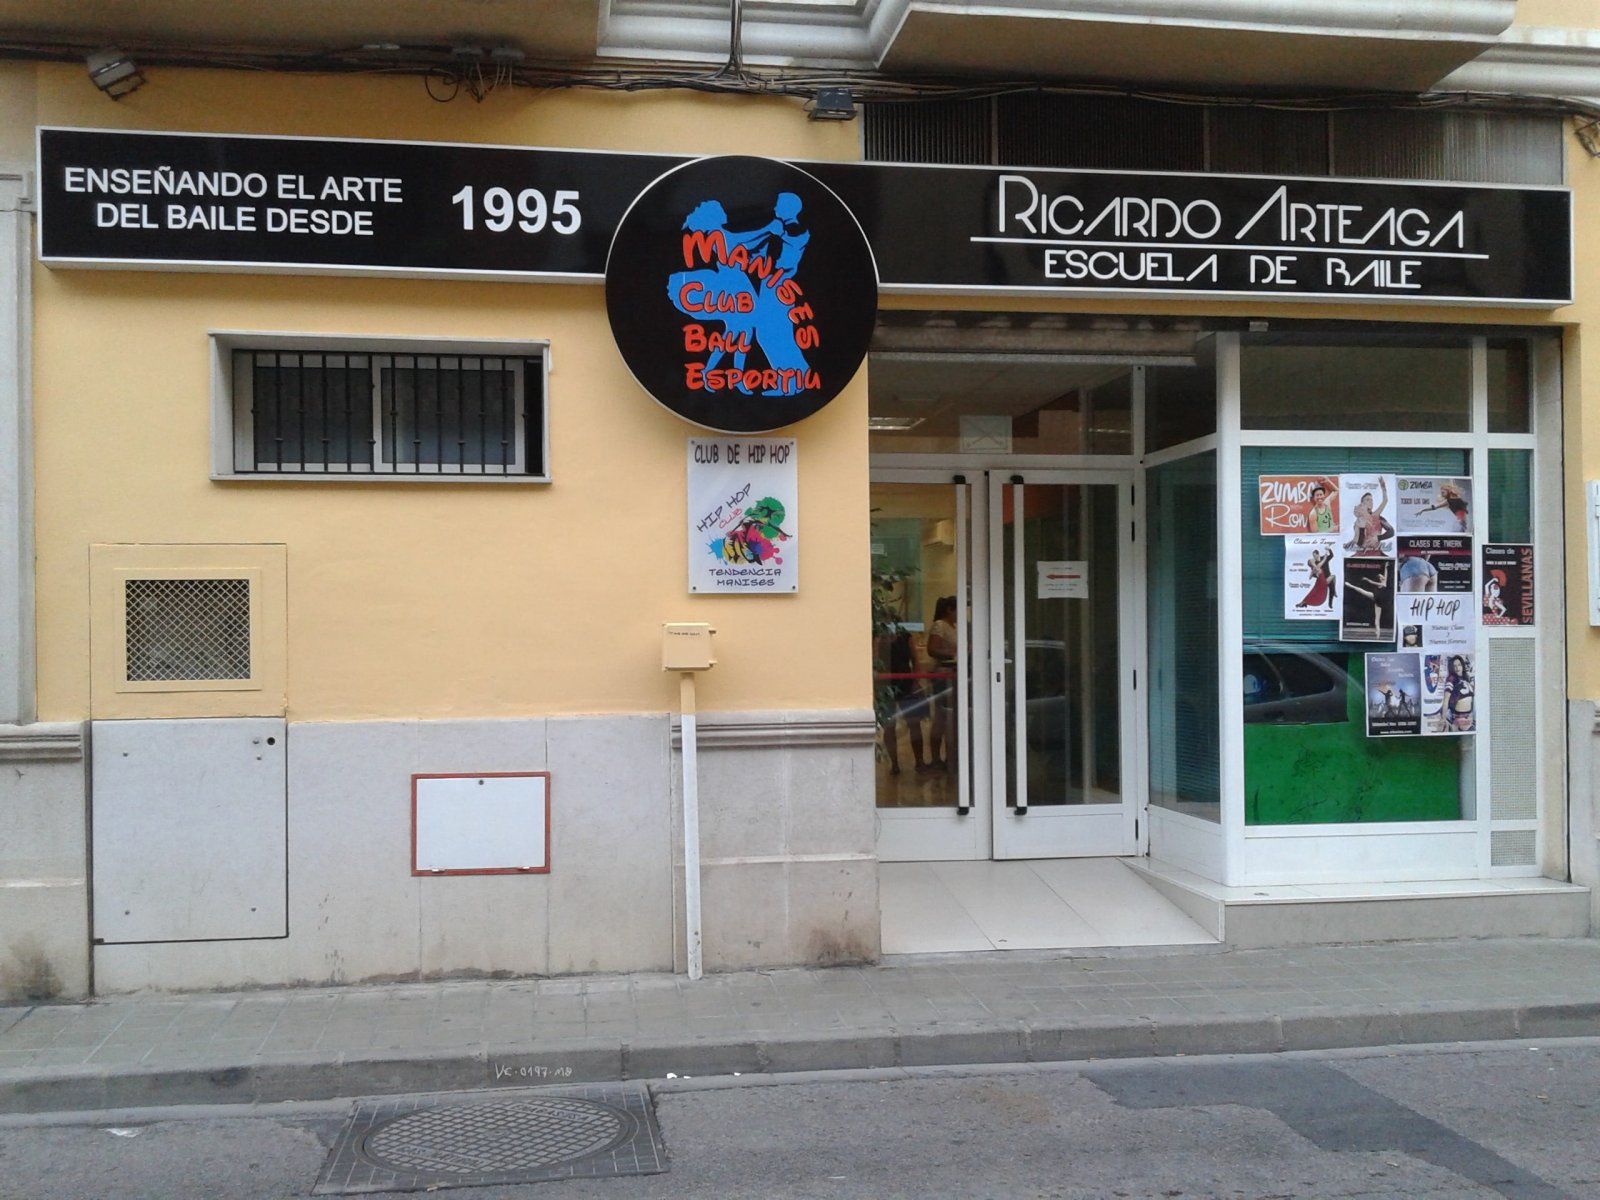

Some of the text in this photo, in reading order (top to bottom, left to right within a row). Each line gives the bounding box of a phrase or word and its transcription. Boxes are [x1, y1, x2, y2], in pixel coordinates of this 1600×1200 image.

[65, 165, 402, 203] ENSEÑANDO EL ARTE
[97, 203, 373, 236] DEL BAILE DESDE
[452, 185, 582, 235] 1995
[999, 175, 1465, 248] RICARDO ARTEAGA
[1044, 249, 1218, 283] ESCUELA
[1250, 255, 1298, 285] DE
[679, 282, 754, 313] CLUB
[682, 229, 820, 350] MANISES
[682, 323, 752, 353] BALL
[684, 362, 822, 393] ESPORTIU
[694, 444, 790, 465] CLUB DE HIP HOP
[696, 482, 751, 533] HIP HOP
[1408, 539, 1463, 548] CLASES DE TWERK
[1521, 547, 1534, 624] SEVILLANAS
[1410, 596, 1461, 621] HIP HOP
